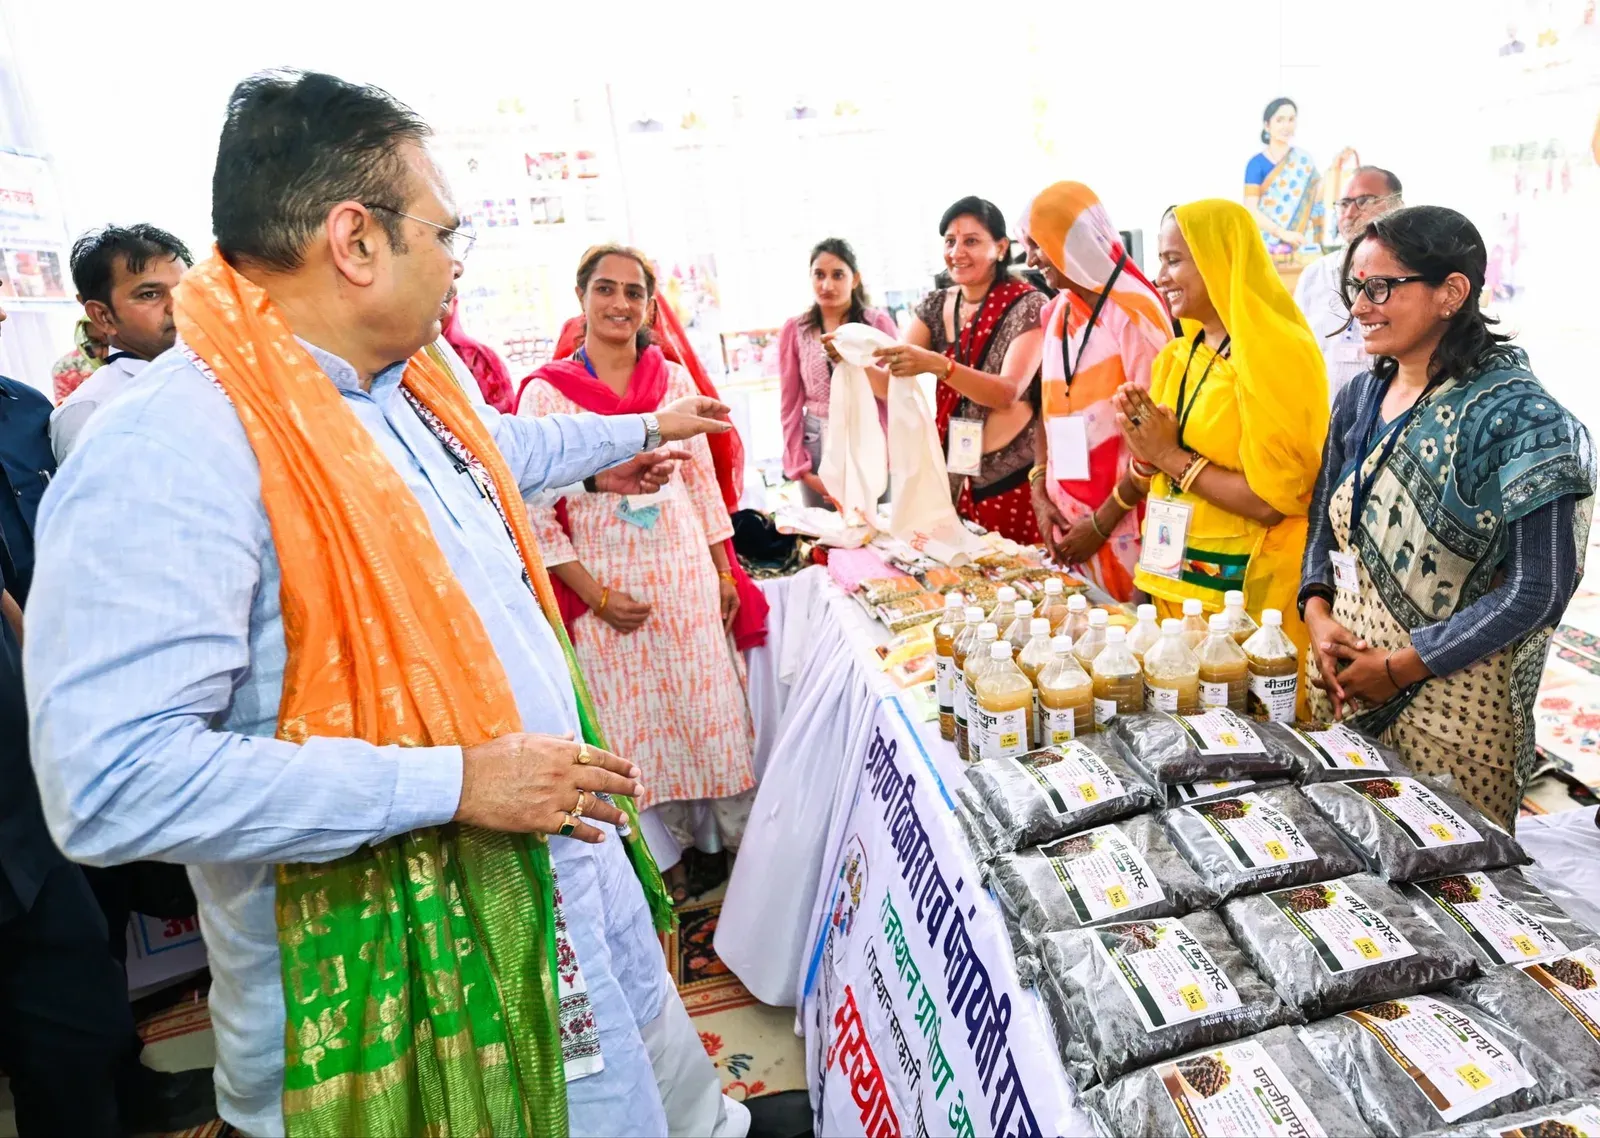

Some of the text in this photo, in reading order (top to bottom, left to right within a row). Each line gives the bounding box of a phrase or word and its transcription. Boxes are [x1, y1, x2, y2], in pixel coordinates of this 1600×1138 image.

[887, 774, 934, 900] विकास
[1120, 852, 1149, 890] कम्पोस्ट
[1191, 948, 1228, 992] कम्पोस्ट
